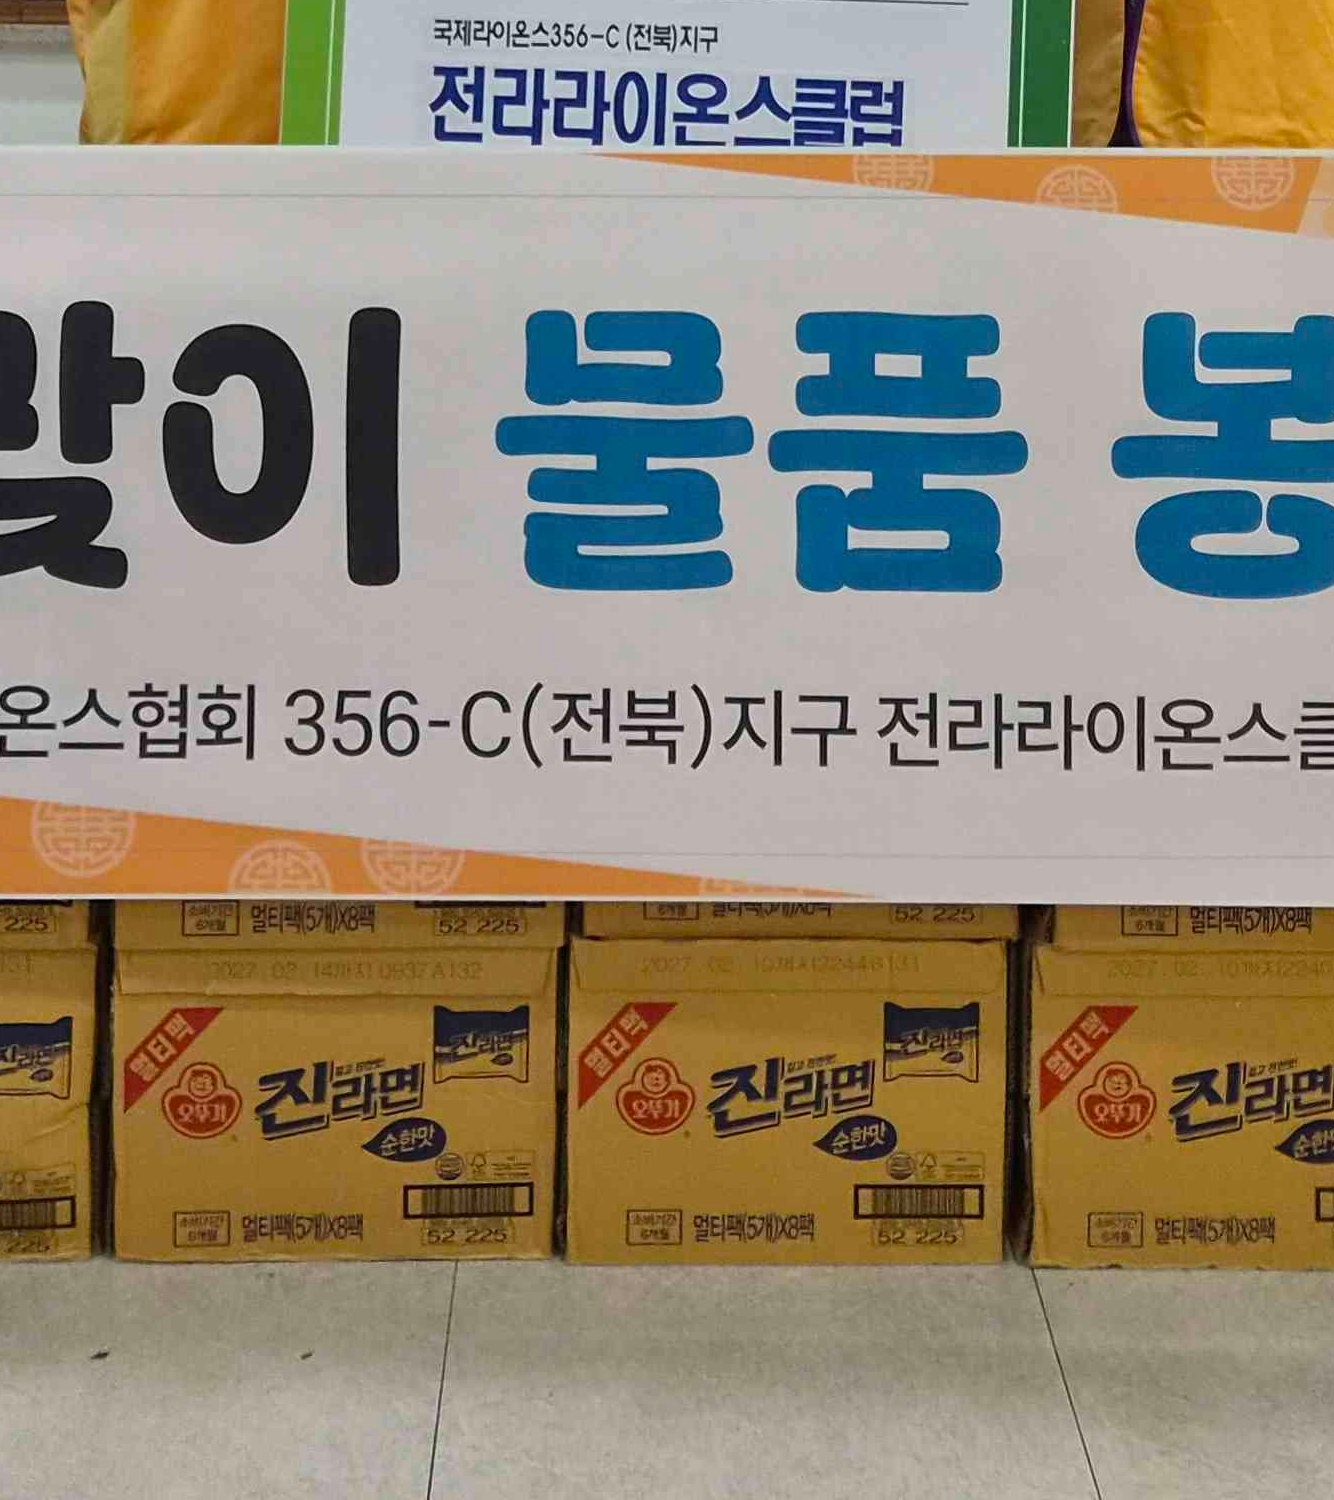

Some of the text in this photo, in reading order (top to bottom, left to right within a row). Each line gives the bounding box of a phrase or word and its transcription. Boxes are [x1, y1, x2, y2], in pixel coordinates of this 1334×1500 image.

[434, 19, 718, 53] 국제라이온스356-C (전북)지구
[429, 65, 905, 148] 전라라이온스클럽
[496, 311, 1028, 592] 물품
[284, 683, 857, 770] 356-C(전북)지구
[5, 917, 49, 932] 225
[439, 919, 520, 933] 52 225
[895, 907, 976, 923] 52 225
[585, 1008, 649, 1077] 멀티팩
[255, 1060, 425, 1141] 진라면
[632, 1100, 680, 1120] 오뚜기
[707, 1056, 875, 1138] 진라면
[1093, 1102, 1143, 1124] 오뚜기
[178, 1104, 228, 1125] 오뚜기
[379, 1125, 435, 1157] 순한맛
[832, 1122, 887, 1154] 순한맛
[428, 1228, 508, 1244] 52 225
[878, 1230, 957, 1245] 52 225
